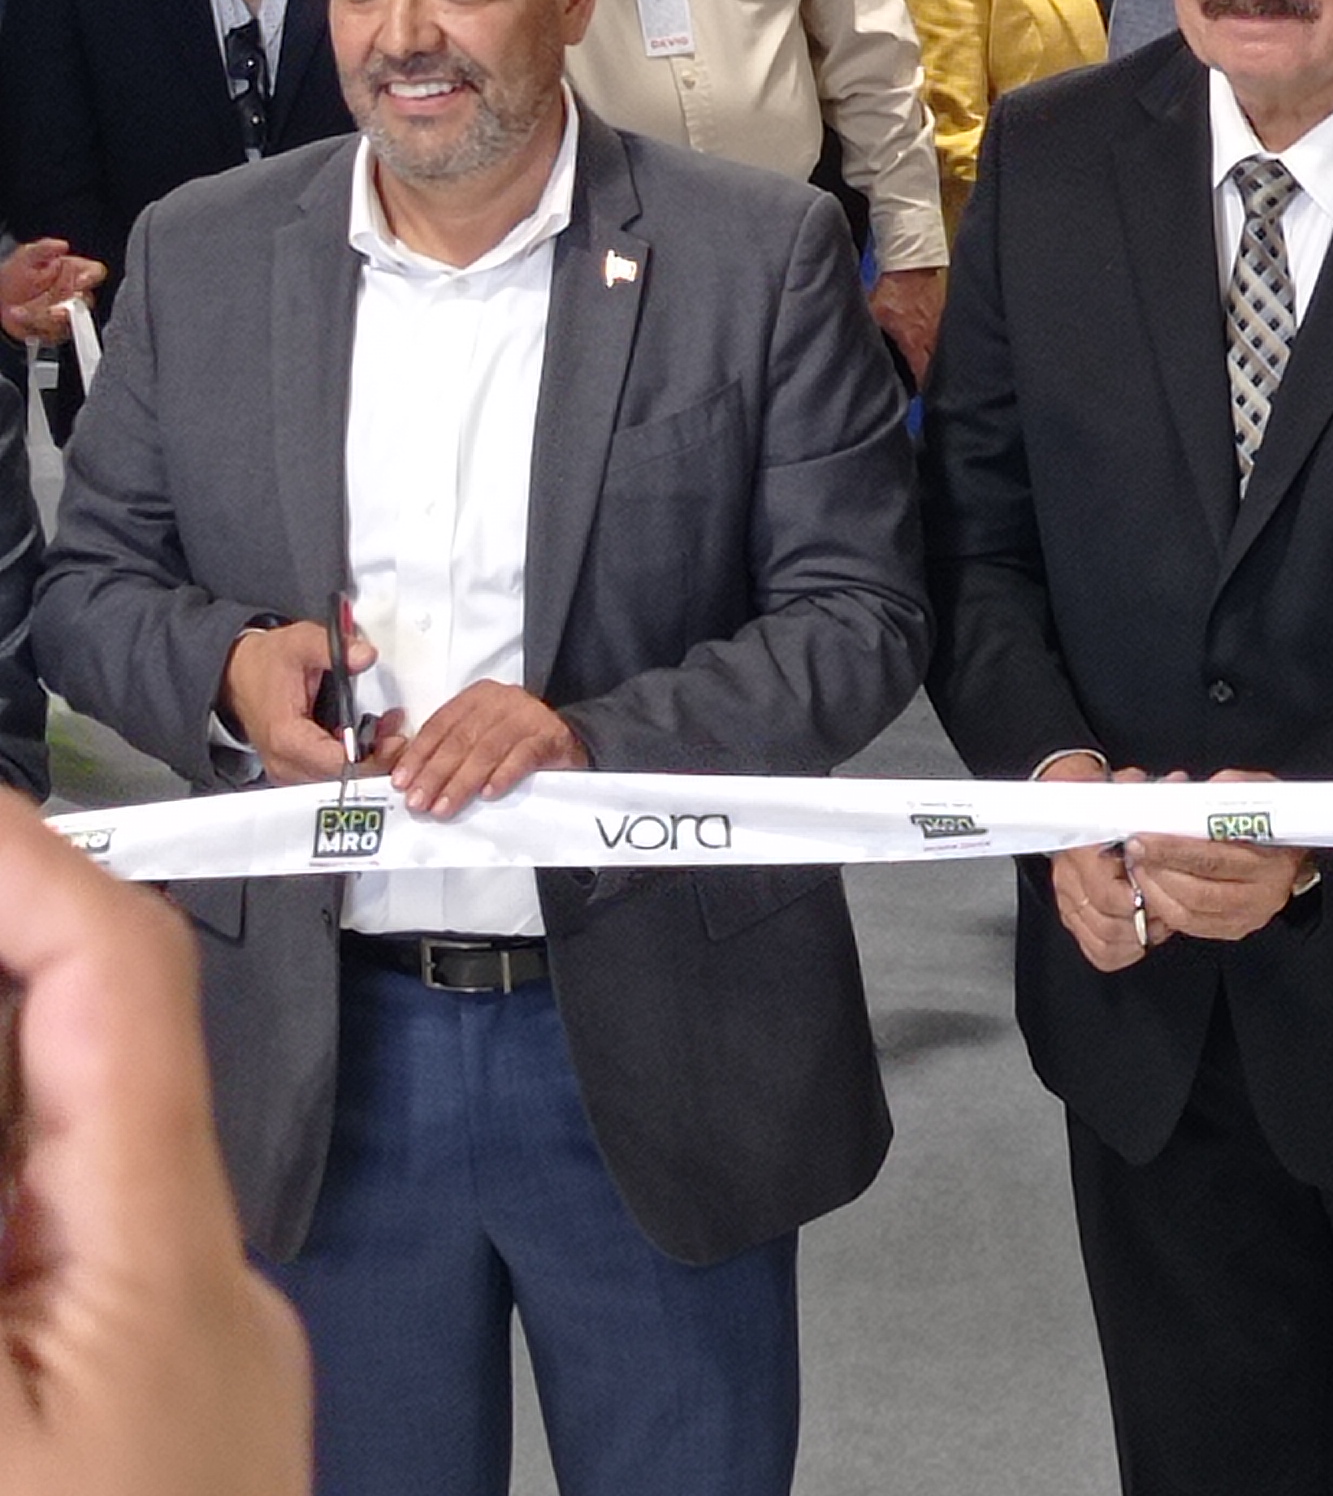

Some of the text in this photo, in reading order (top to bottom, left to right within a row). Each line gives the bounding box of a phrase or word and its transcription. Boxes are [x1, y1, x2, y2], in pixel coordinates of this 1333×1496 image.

[321, 810, 382, 834] EXPO
[597, 812, 732, 852] vora
[1210, 814, 1269, 839] EXPO
[317, 831, 379, 855] MRO
